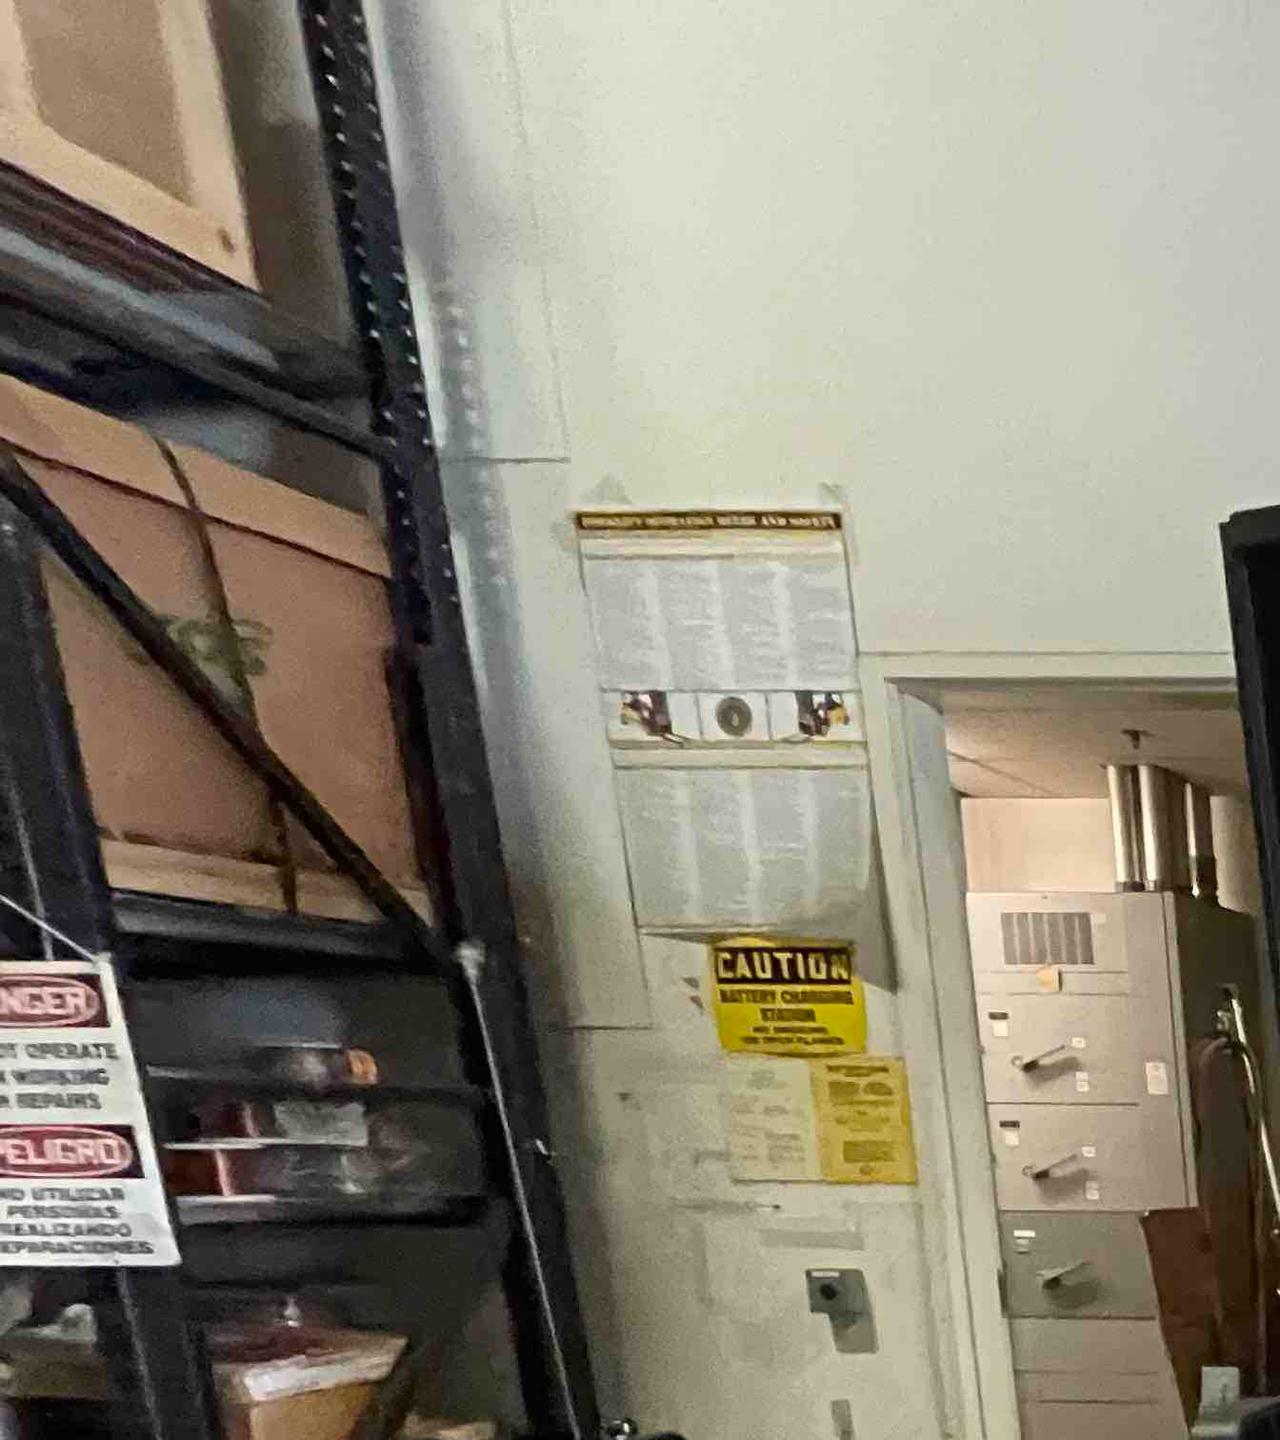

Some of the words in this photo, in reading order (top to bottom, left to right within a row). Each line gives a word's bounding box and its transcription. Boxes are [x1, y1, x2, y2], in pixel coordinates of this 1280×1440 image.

[717, 951, 850, 980] CAUTION
[0, 985, 87, 1017] NGER
[0, 1240, 155, 1255] EPARACIONES
